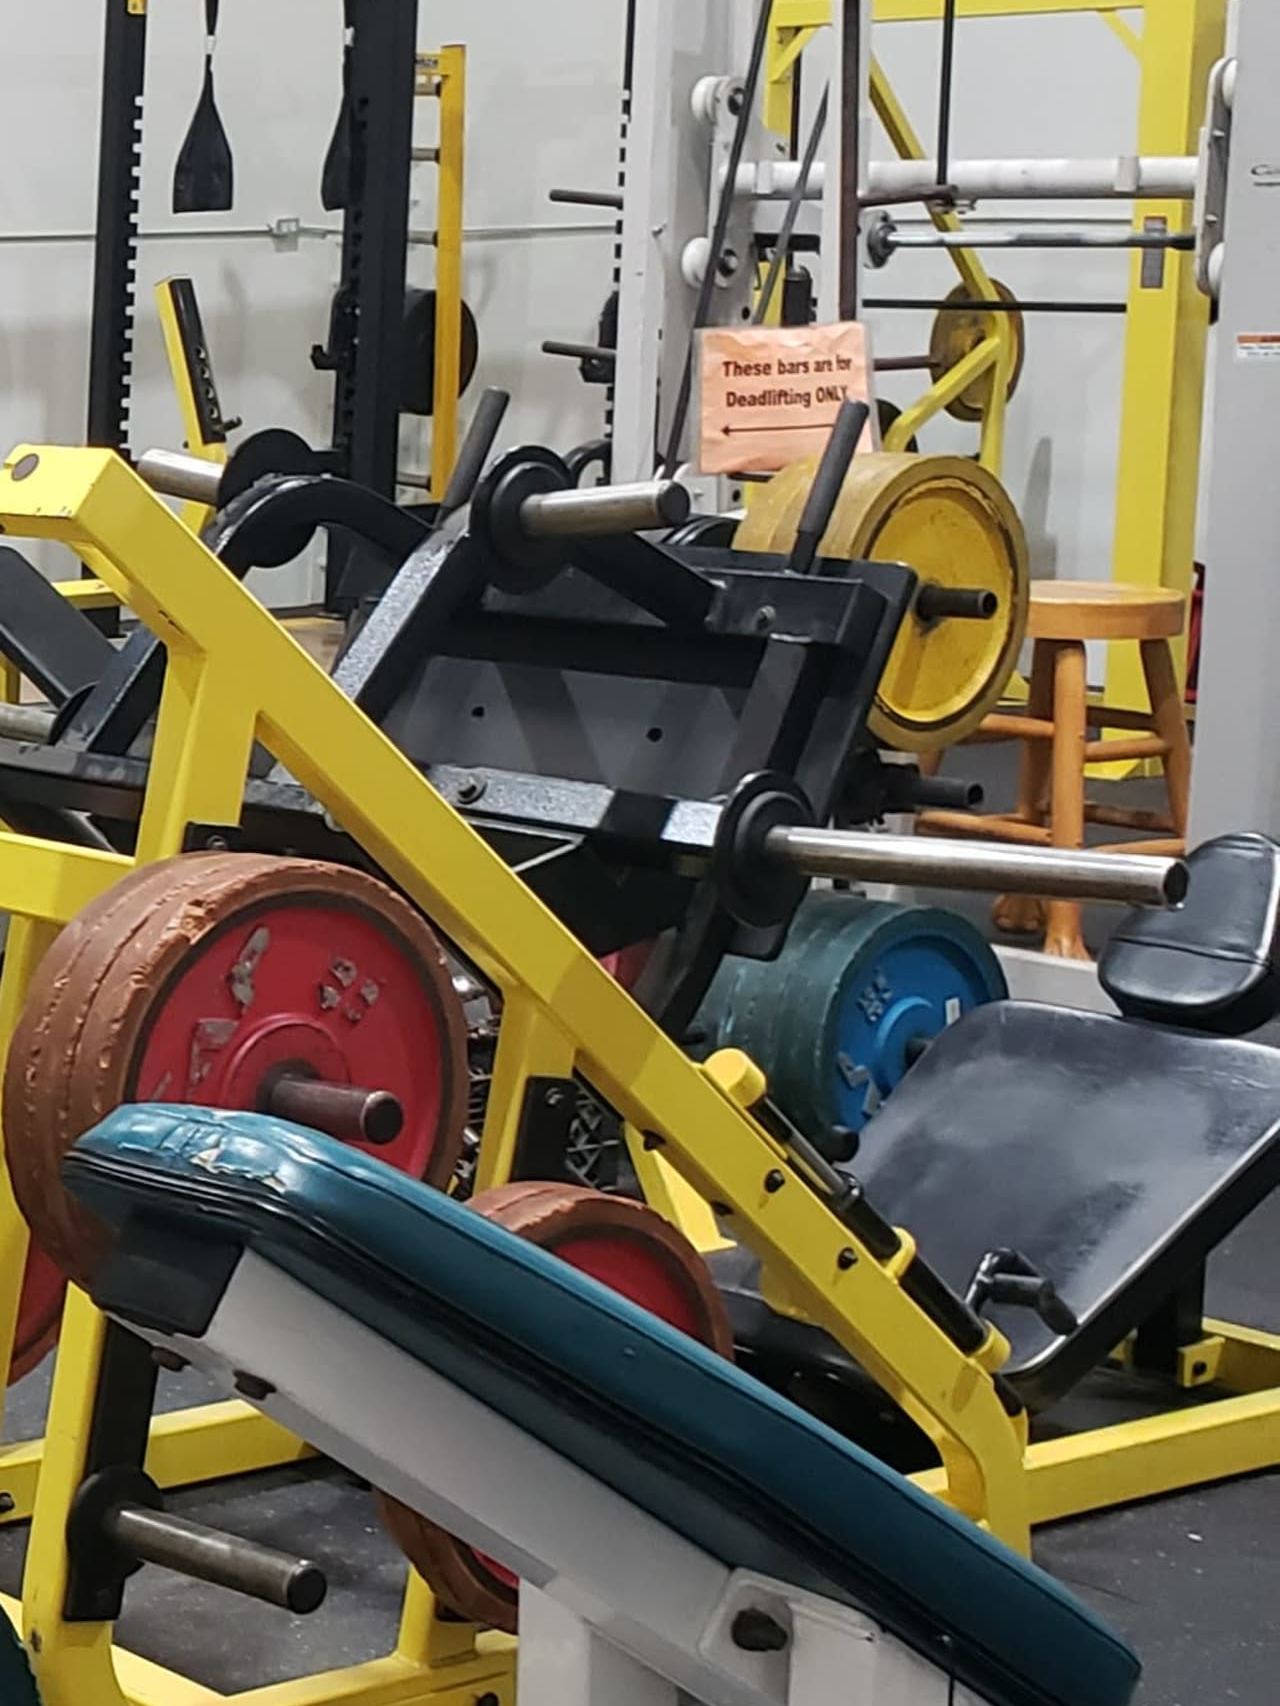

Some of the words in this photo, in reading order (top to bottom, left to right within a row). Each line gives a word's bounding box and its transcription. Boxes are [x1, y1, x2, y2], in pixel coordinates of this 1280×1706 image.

[722, 360, 772, 377] These
[778, 358, 810, 375] bars
[814, 358, 833, 372] are
[836, 354, 852, 371] for
[726, 388, 812, 408] Deadlifting
[815, 385, 847, 403] ONLY
